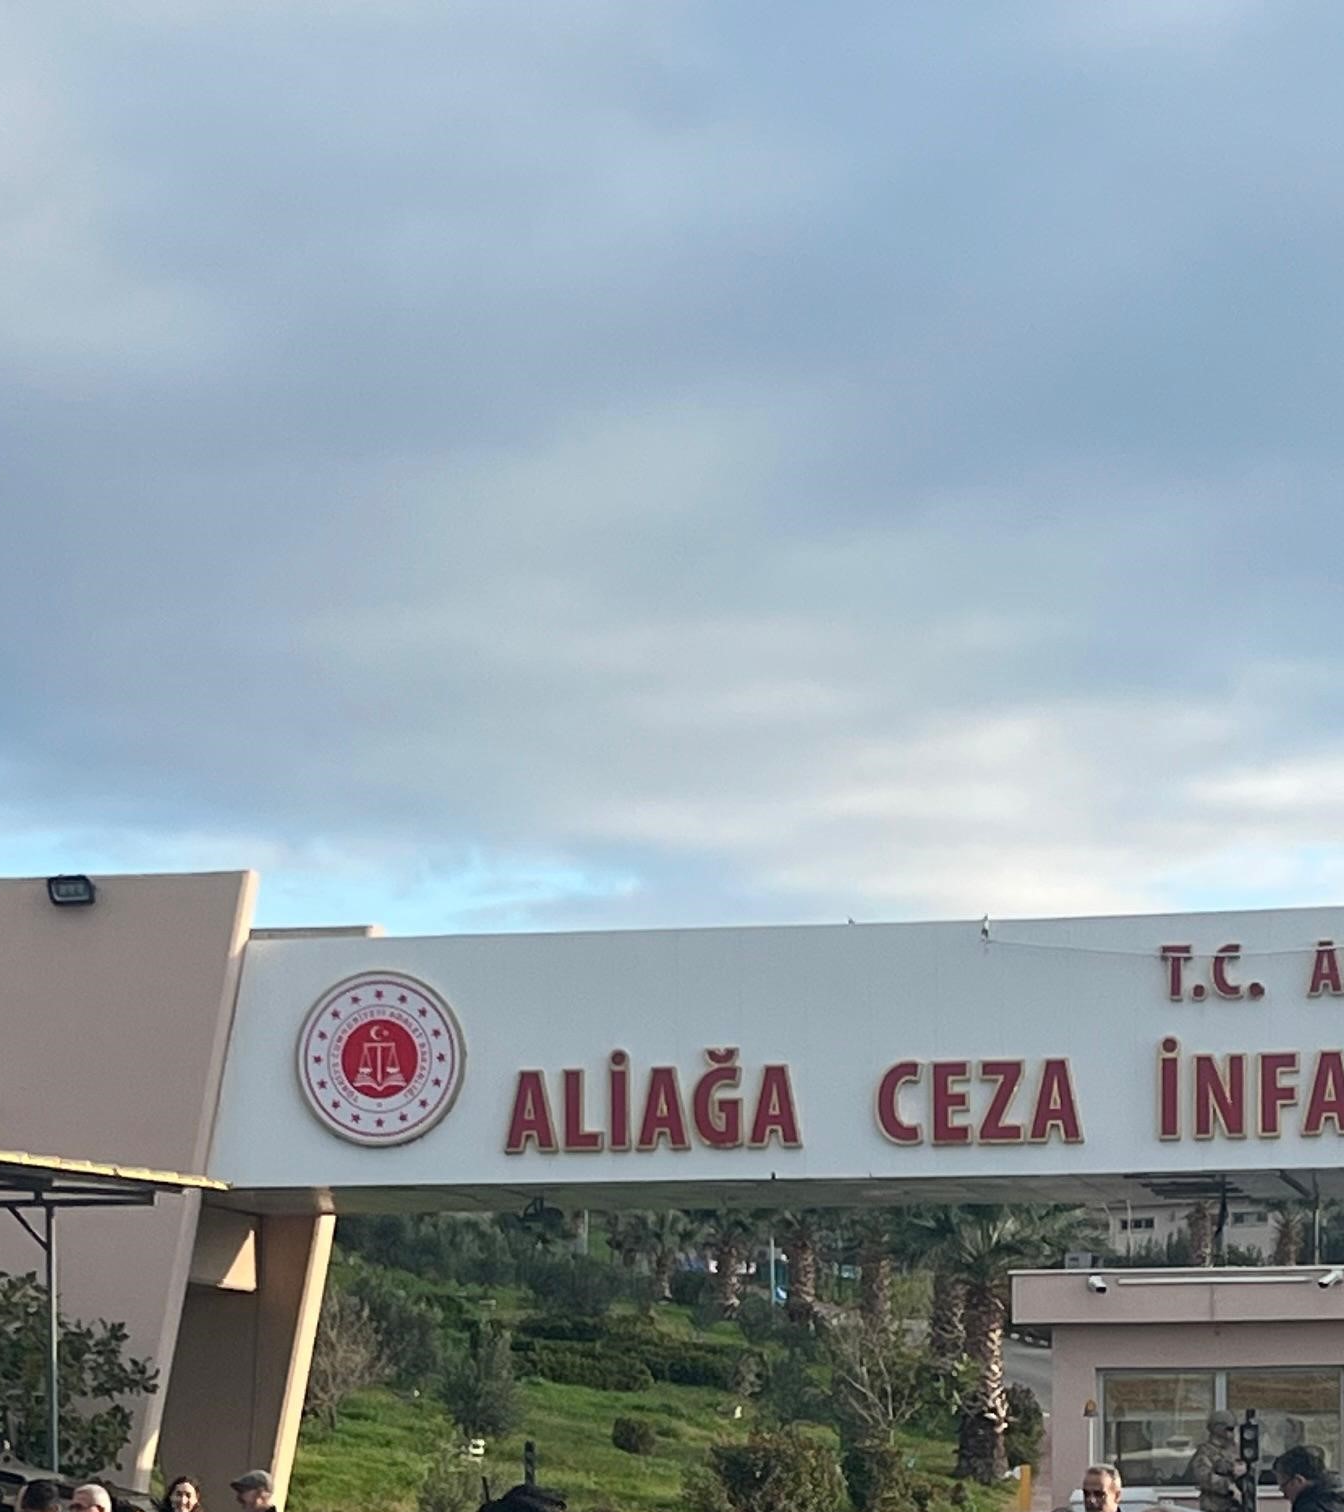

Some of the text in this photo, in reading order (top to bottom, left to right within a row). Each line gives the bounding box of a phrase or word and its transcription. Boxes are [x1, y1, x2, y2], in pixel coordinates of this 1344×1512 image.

[1160, 944, 1265, 1000] T.C.
[505, 1046, 802, 1153] ALİAĞA
[875, 1057, 1084, 1145] CEZA
